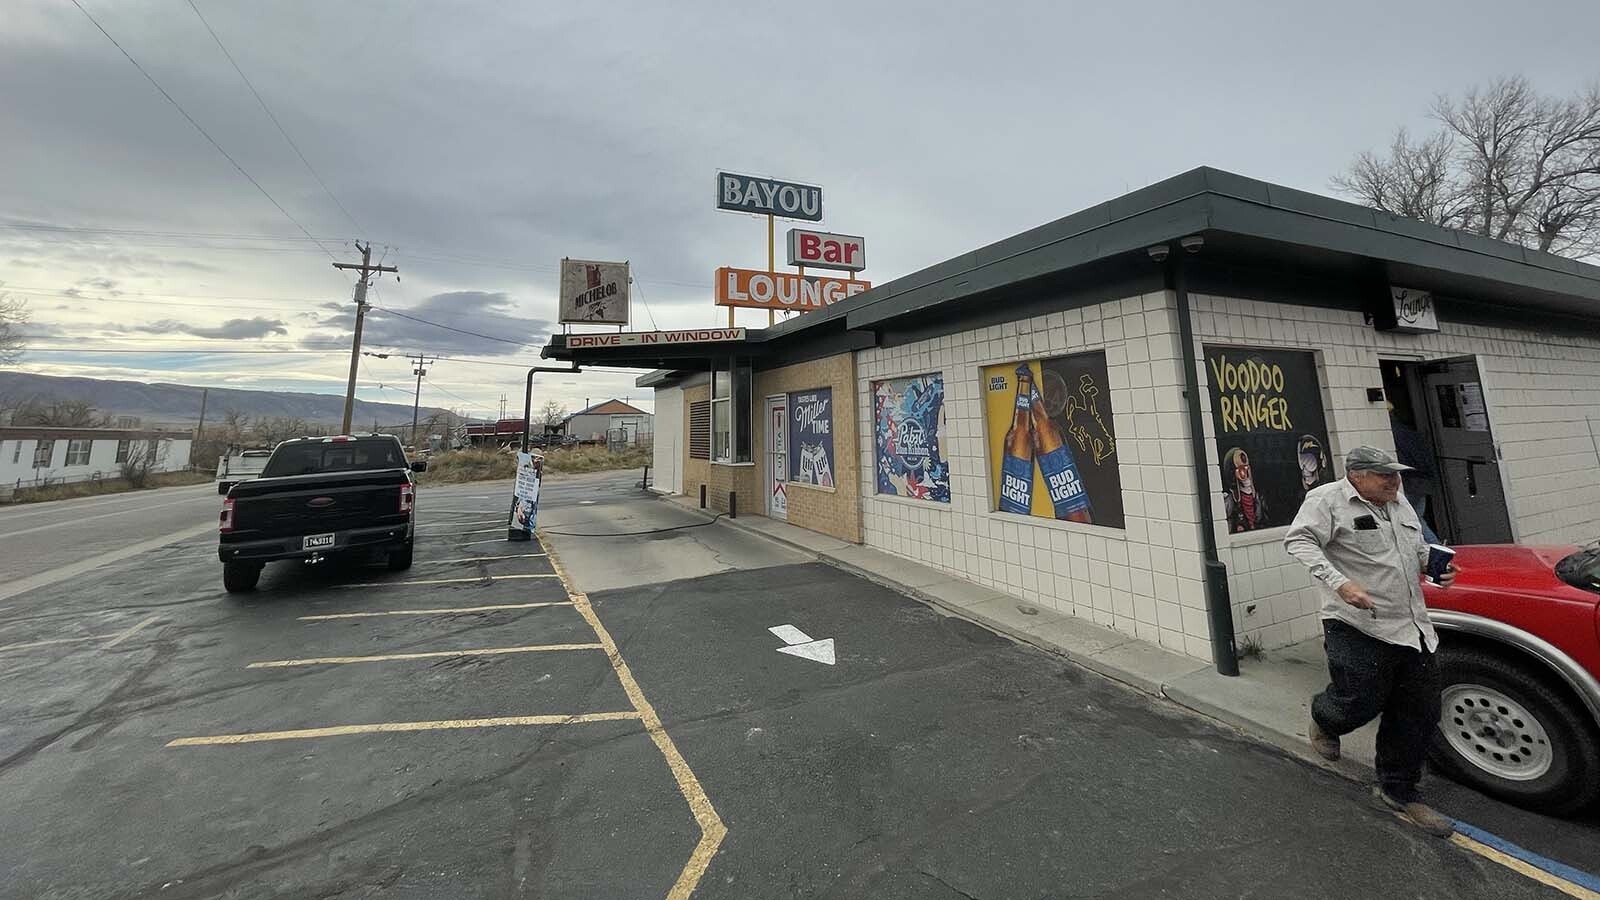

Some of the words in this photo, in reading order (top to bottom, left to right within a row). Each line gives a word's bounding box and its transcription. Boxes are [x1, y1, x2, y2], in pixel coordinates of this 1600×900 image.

[723, 176, 818, 216] BAYOU
[800, 233, 859, 264] Bar
[574, 282, 617, 310] MICHELOB
[570, 335, 621, 347] DRIVE
[641, 333, 658, 344] IN
[665, 329, 741, 342] WINDOW
[991, 376, 1005, 384] BUD
[1210, 355, 1284, 393] VOODOO
[989, 383, 1008, 391] LIGHT
[795, 399, 829, 433] Miller
[1220, 394, 1293, 433] RANGER
[812, 420, 830, 434] TIME
[897, 422, 926, 447] Pabst
[1005, 474, 1028, 493] BUD
[1048, 469, 1075, 489] BUD
[1050, 479, 1083, 502] LIGHT
[1002, 484, 1031, 506] LIGHT
